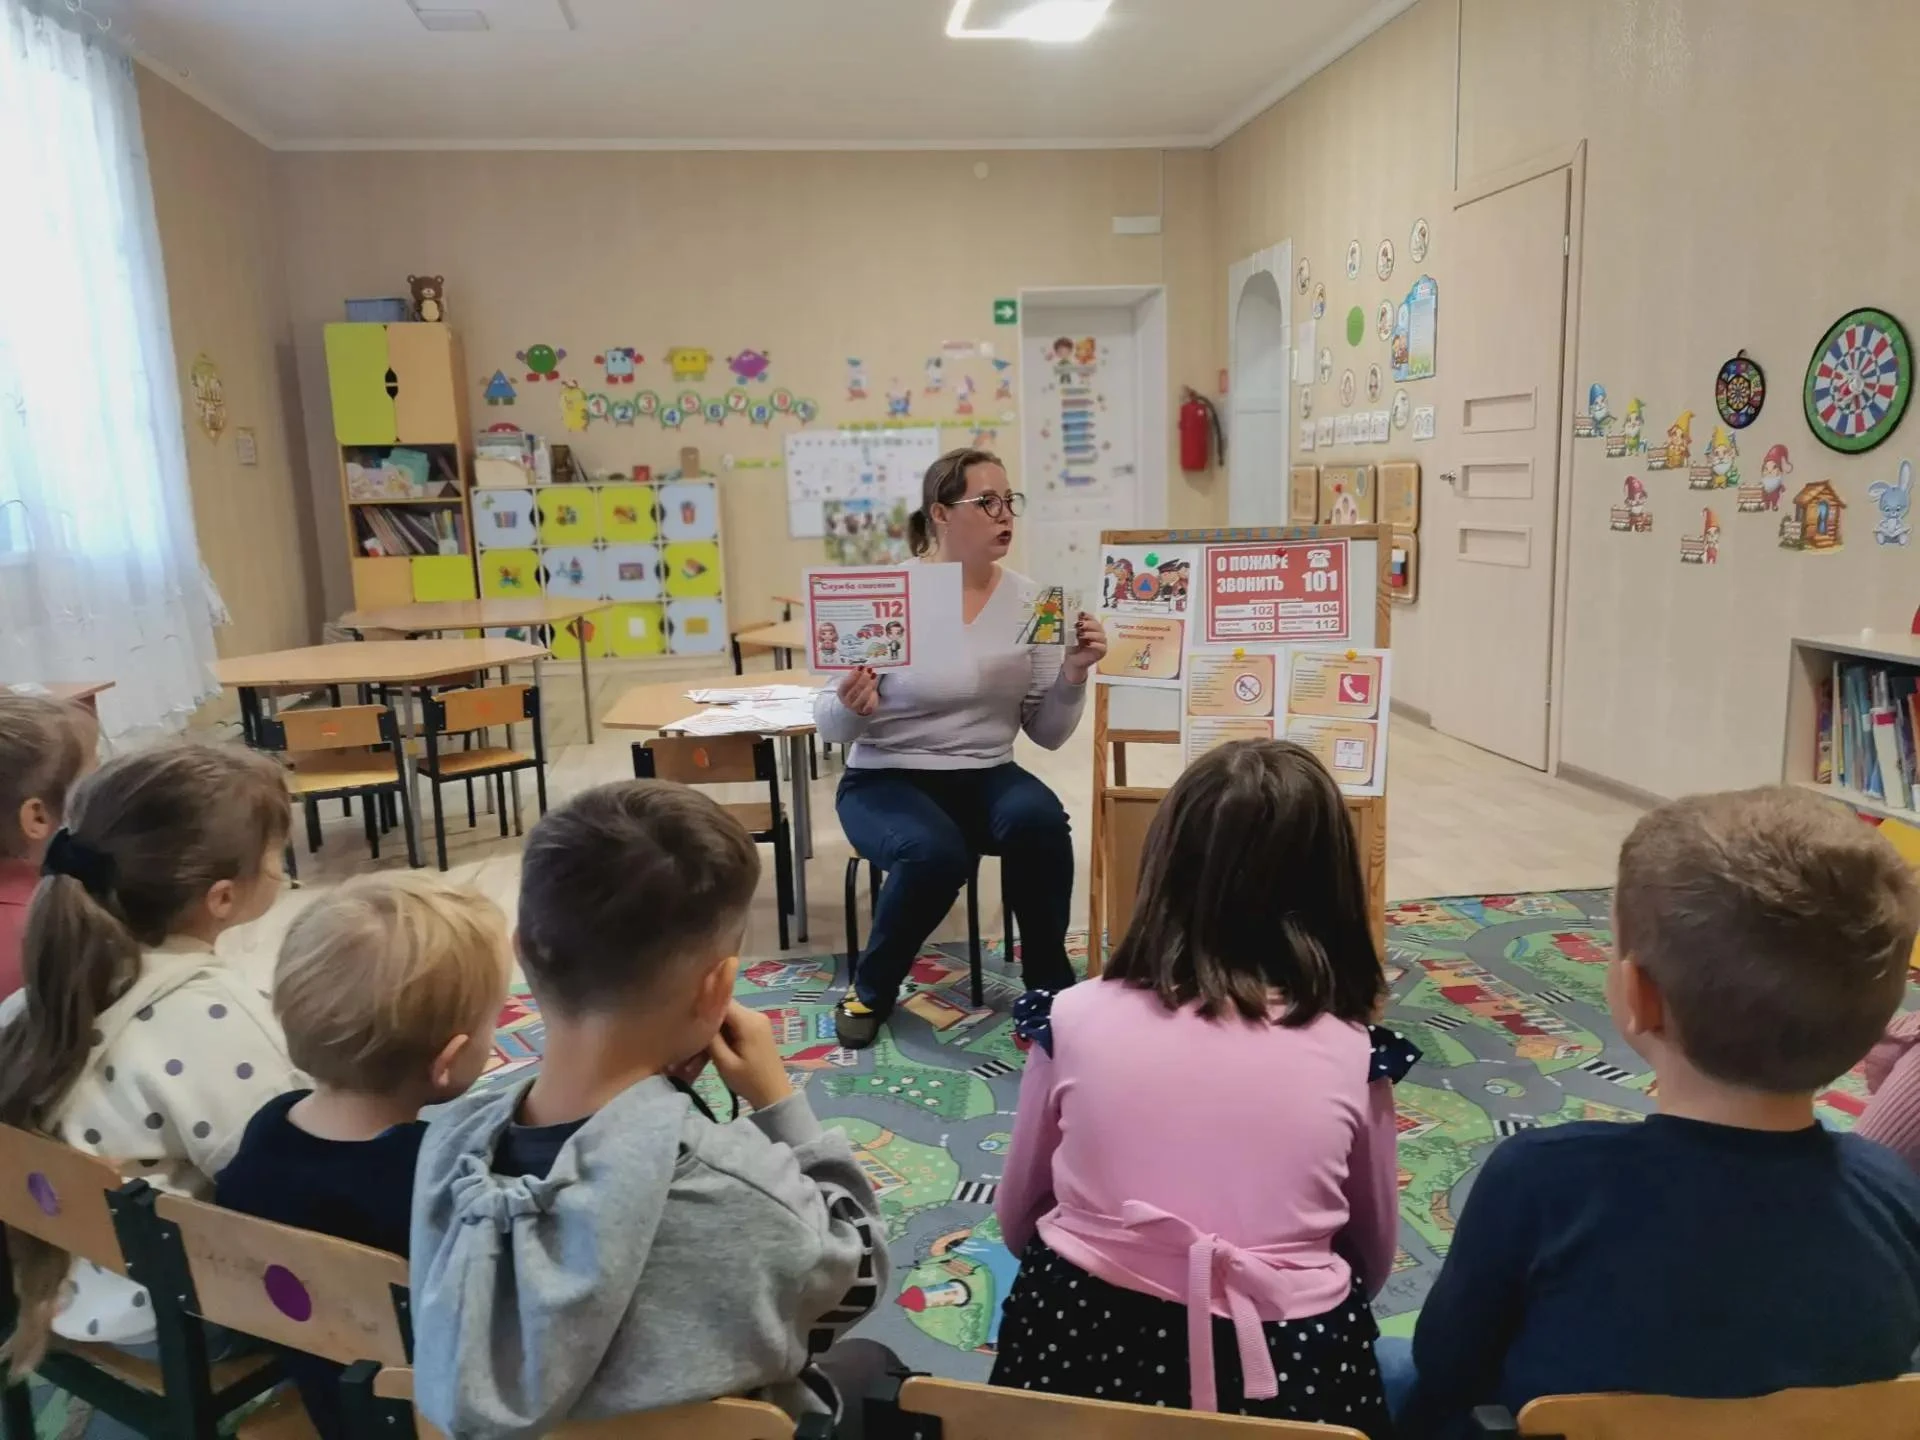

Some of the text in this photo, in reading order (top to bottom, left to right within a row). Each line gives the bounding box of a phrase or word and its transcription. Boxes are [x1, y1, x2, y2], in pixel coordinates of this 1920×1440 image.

[592, 400, 601, 414] 1
[619, 407, 630, 420] 2
[643, 397, 653, 411] 3
[665, 408, 676, 422] 4
[685, 397, 696, 411] 5
[710, 404, 721, 418] 6
[732, 394, 742, 409] 7
[756, 406, 766, 420] 8
[1217, 554, 1288, 572] О ПОЖАРЕ
[1217, 575, 1285, 593] ЗВОНИТЬ
[1301, 570, 1338, 592] 101
[872, 600, 904, 619] 112
[1251, 606, 1273, 616] 102
[1315, 603, 1338, 613] 104
[1251, 621, 1273, 631] 103
[1316, 619, 1338, 630] 112
